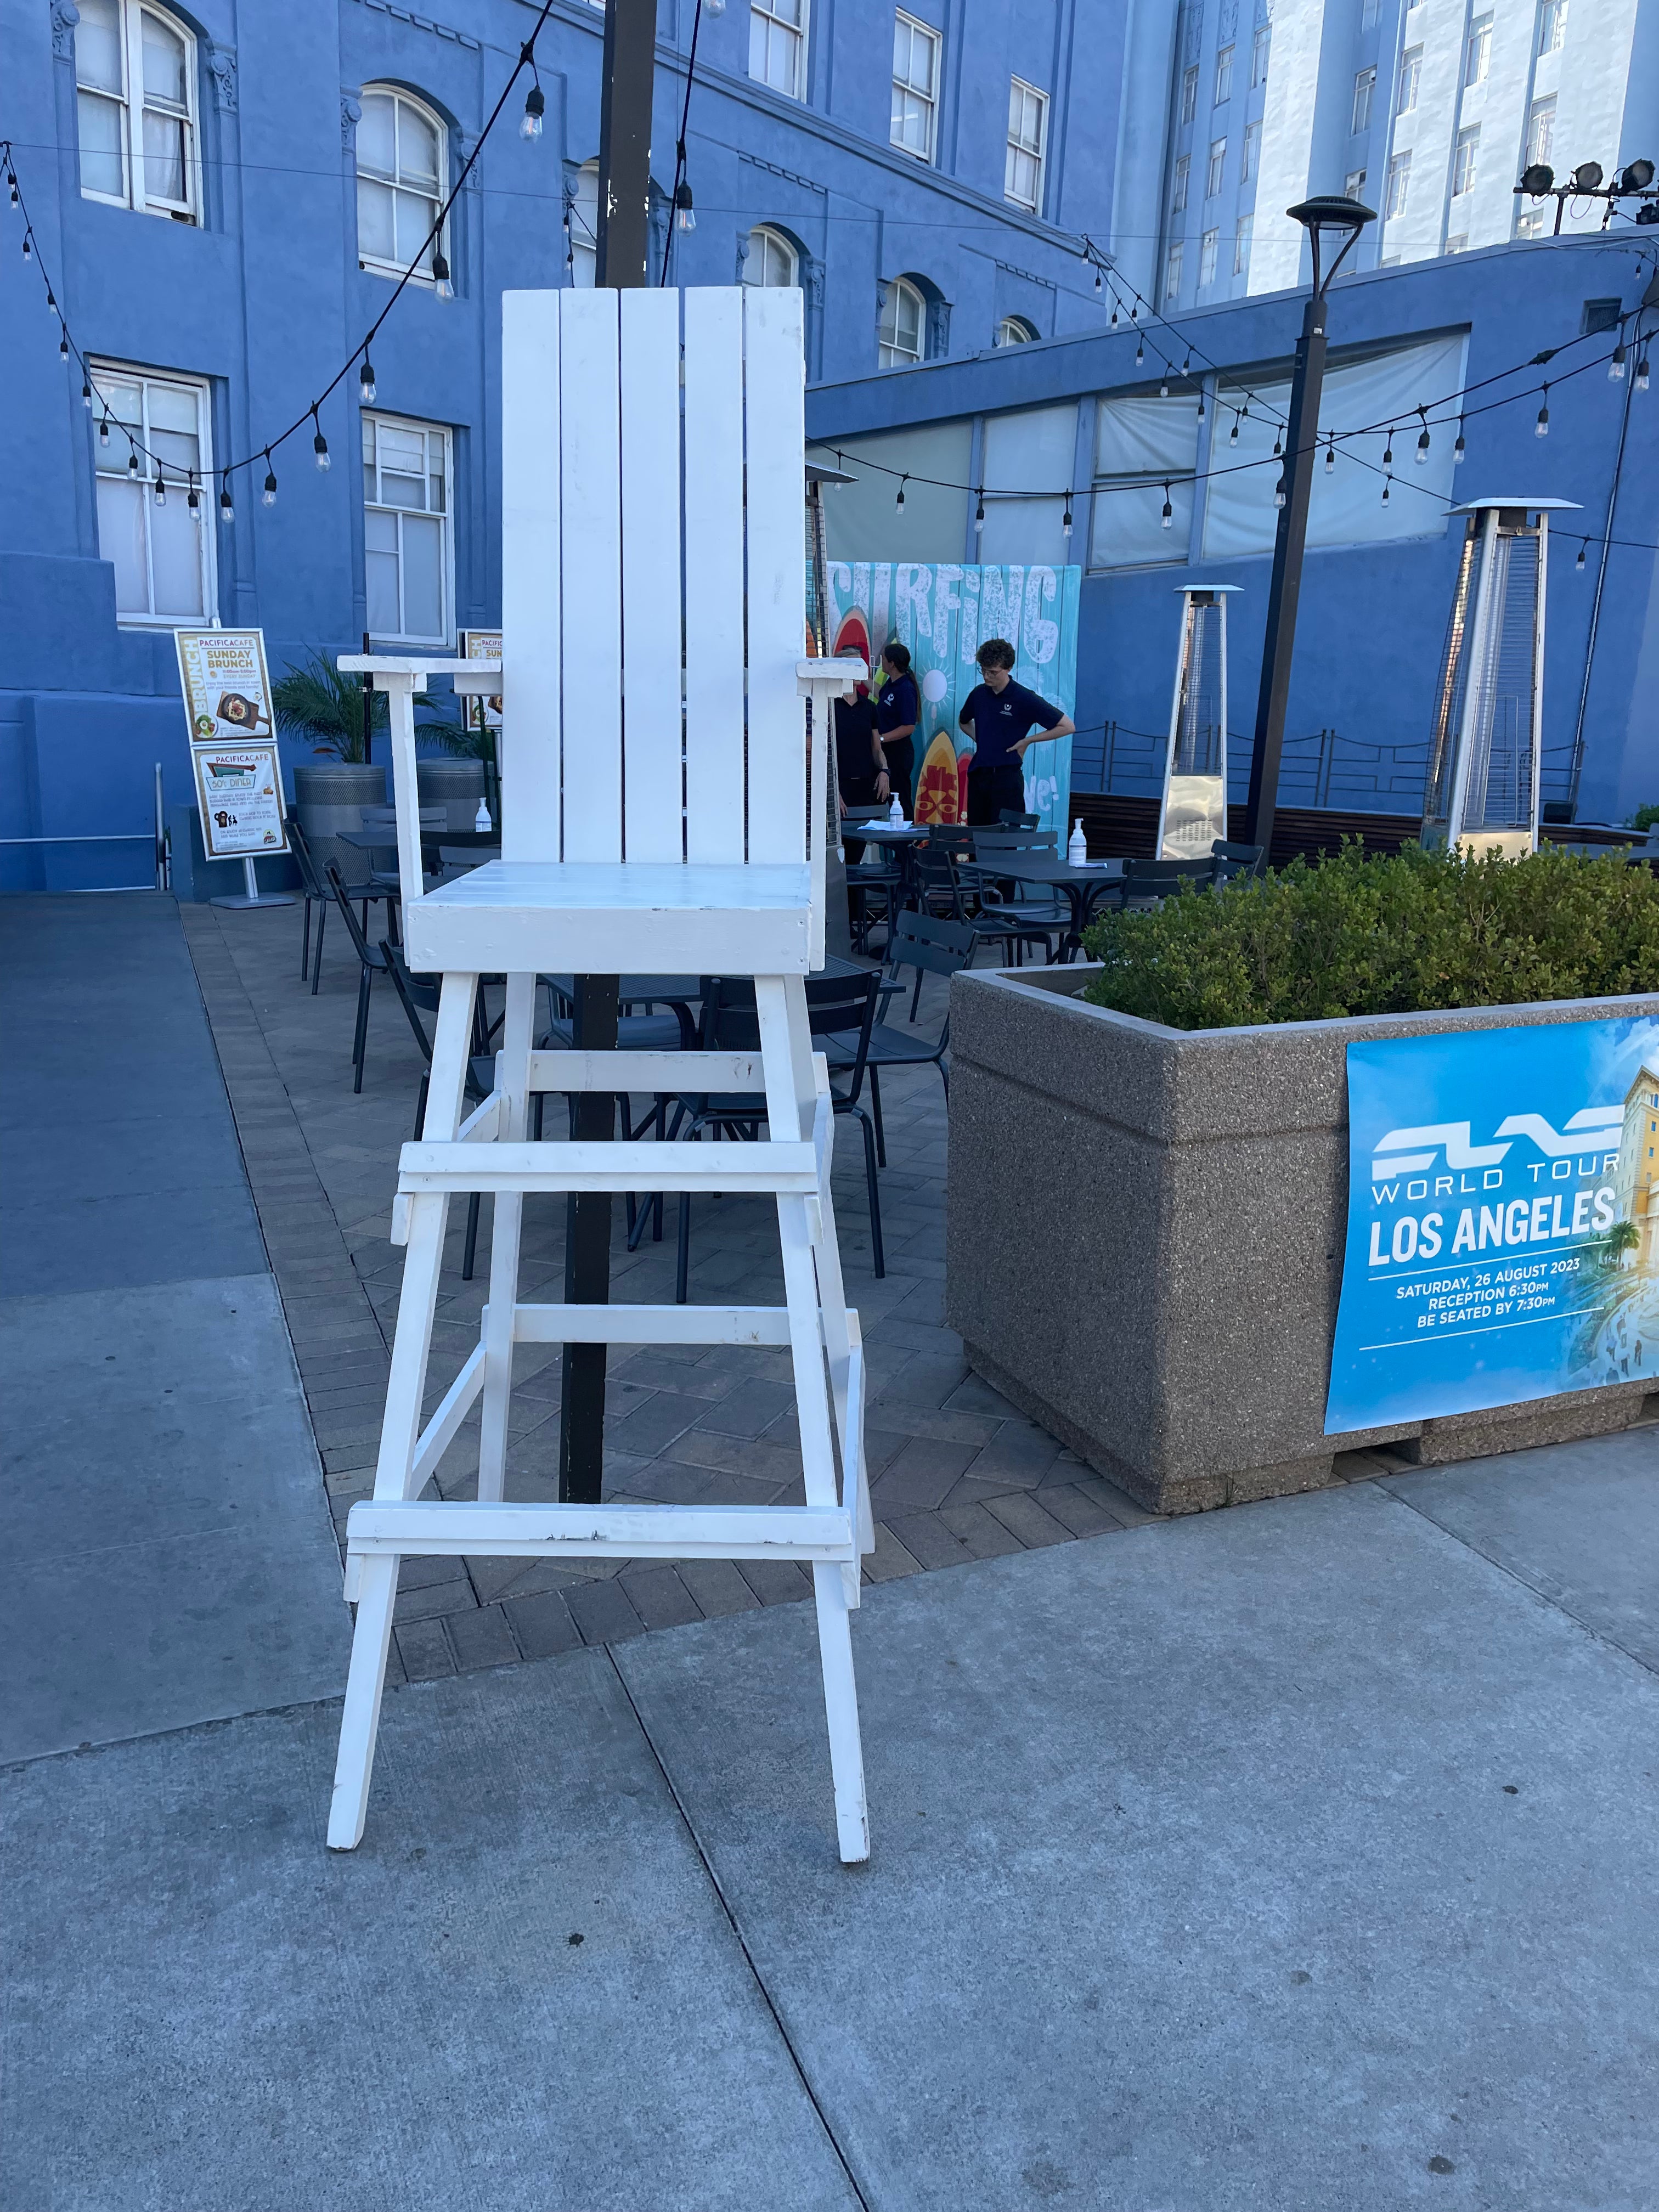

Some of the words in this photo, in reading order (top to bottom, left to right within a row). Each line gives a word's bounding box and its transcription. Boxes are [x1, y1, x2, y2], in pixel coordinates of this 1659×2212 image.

[207, 650, 251, 658] SUNDAY
[208, 659, 253, 668] BRUNCH
[230, 778, 252, 787] DINER
[1371, 1169, 1503, 1205] WORLD
[1527, 1153, 1620, 1183] TOUR
[1368, 1212, 1443, 1267] LOS
[1451, 1186, 1616, 1254] ANGELES
[1396, 1277, 1471, 1299] SATURDAY,
[1474, 1273, 1491, 1288] 26
[1494, 1263, 1548, 1284] AUGUST
[1550, 1257, 1581, 1274] 2023
[1428, 1286, 1505, 1311] RECEPTION
[1509, 1281, 1549, 1297] 6:30PM
[1417, 1314, 1436, 1328] BE
[1438, 1305, 1492, 1324] SEATED
[1495, 1301, 1513, 1316] BY
[1516, 1296, 1556, 1312] 7:30PM
